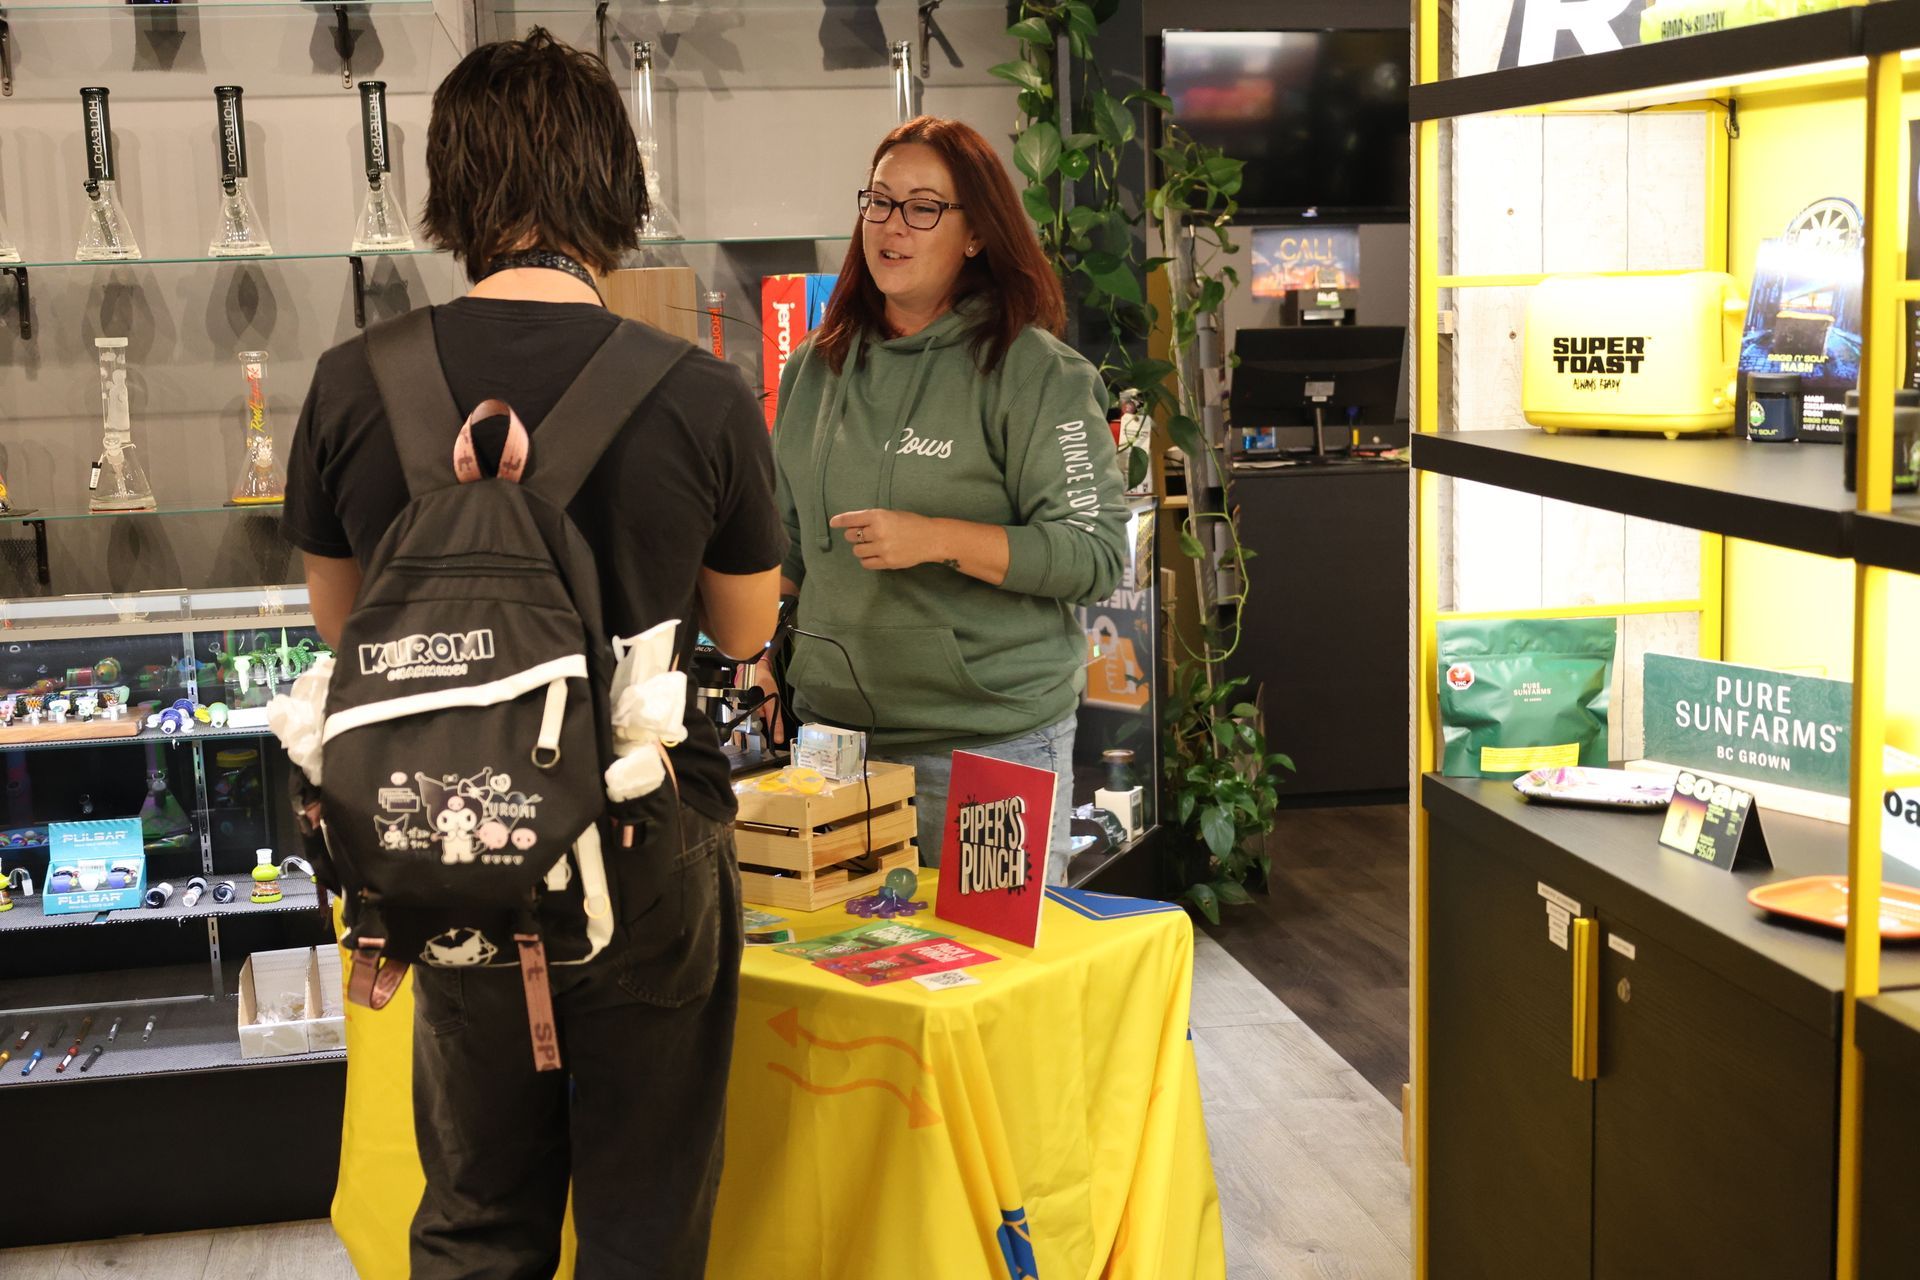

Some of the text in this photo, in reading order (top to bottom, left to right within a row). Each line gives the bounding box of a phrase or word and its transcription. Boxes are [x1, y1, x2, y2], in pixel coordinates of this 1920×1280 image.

[1280, 237, 1333, 261] CALI
[1553, 356, 1645, 374] TOAST
[1055, 420, 1095, 484] PRINCE
[359, 629, 495, 675] KUROMI
[1716, 676, 1792, 714] PURE
[1716, 745, 1791, 772] BC GROWN
[1676, 772, 1750, 812] soar
[484, 801, 537, 818] UROMI
[959, 796, 1025, 850] PIPER'S
[63, 830, 128, 843] PULSAR
[961, 842, 1025, 896] PUNCH
[57, 892, 124, 906] PULSAR
